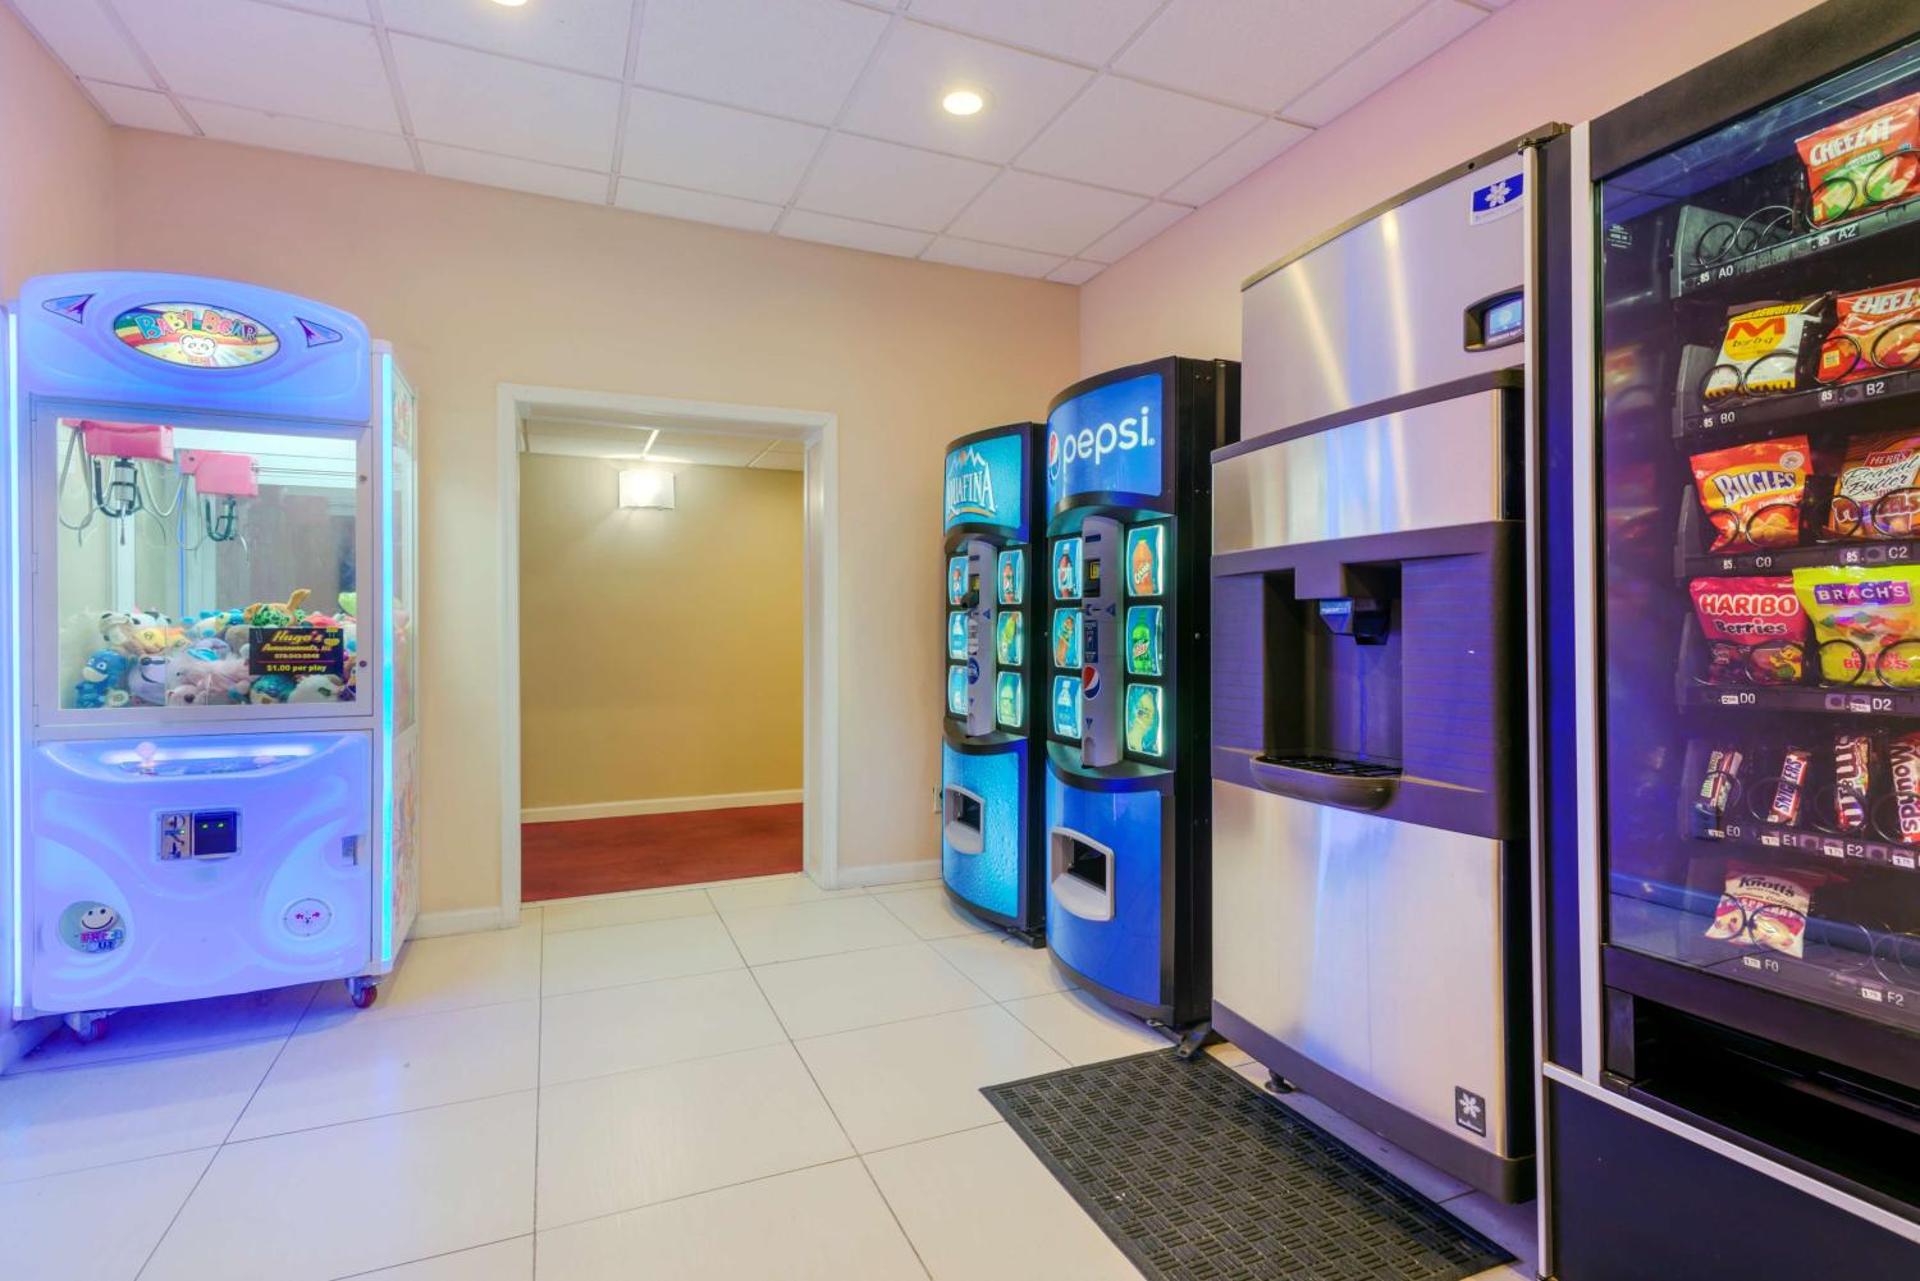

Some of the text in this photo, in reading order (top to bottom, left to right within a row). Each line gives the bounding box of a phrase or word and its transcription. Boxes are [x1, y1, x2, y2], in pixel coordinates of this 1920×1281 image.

[1838, 226, 1856, 241] A2
[1866, 382, 1885, 396] B2
[1713, 470, 1797, 507] BUGLES
[1888, 546, 1908, 559] C2
[1816, 584, 1907, 601] BRACH'S
[1699, 594, 1799, 616] HARIBO
[1712, 617, 1788, 636] Berries
[1872, 698, 1892, 711] D2
[1783, 834, 1797, 847] E1
[1846, 844, 1864, 858] E2
[1887, 991, 1904, 1006] F2
